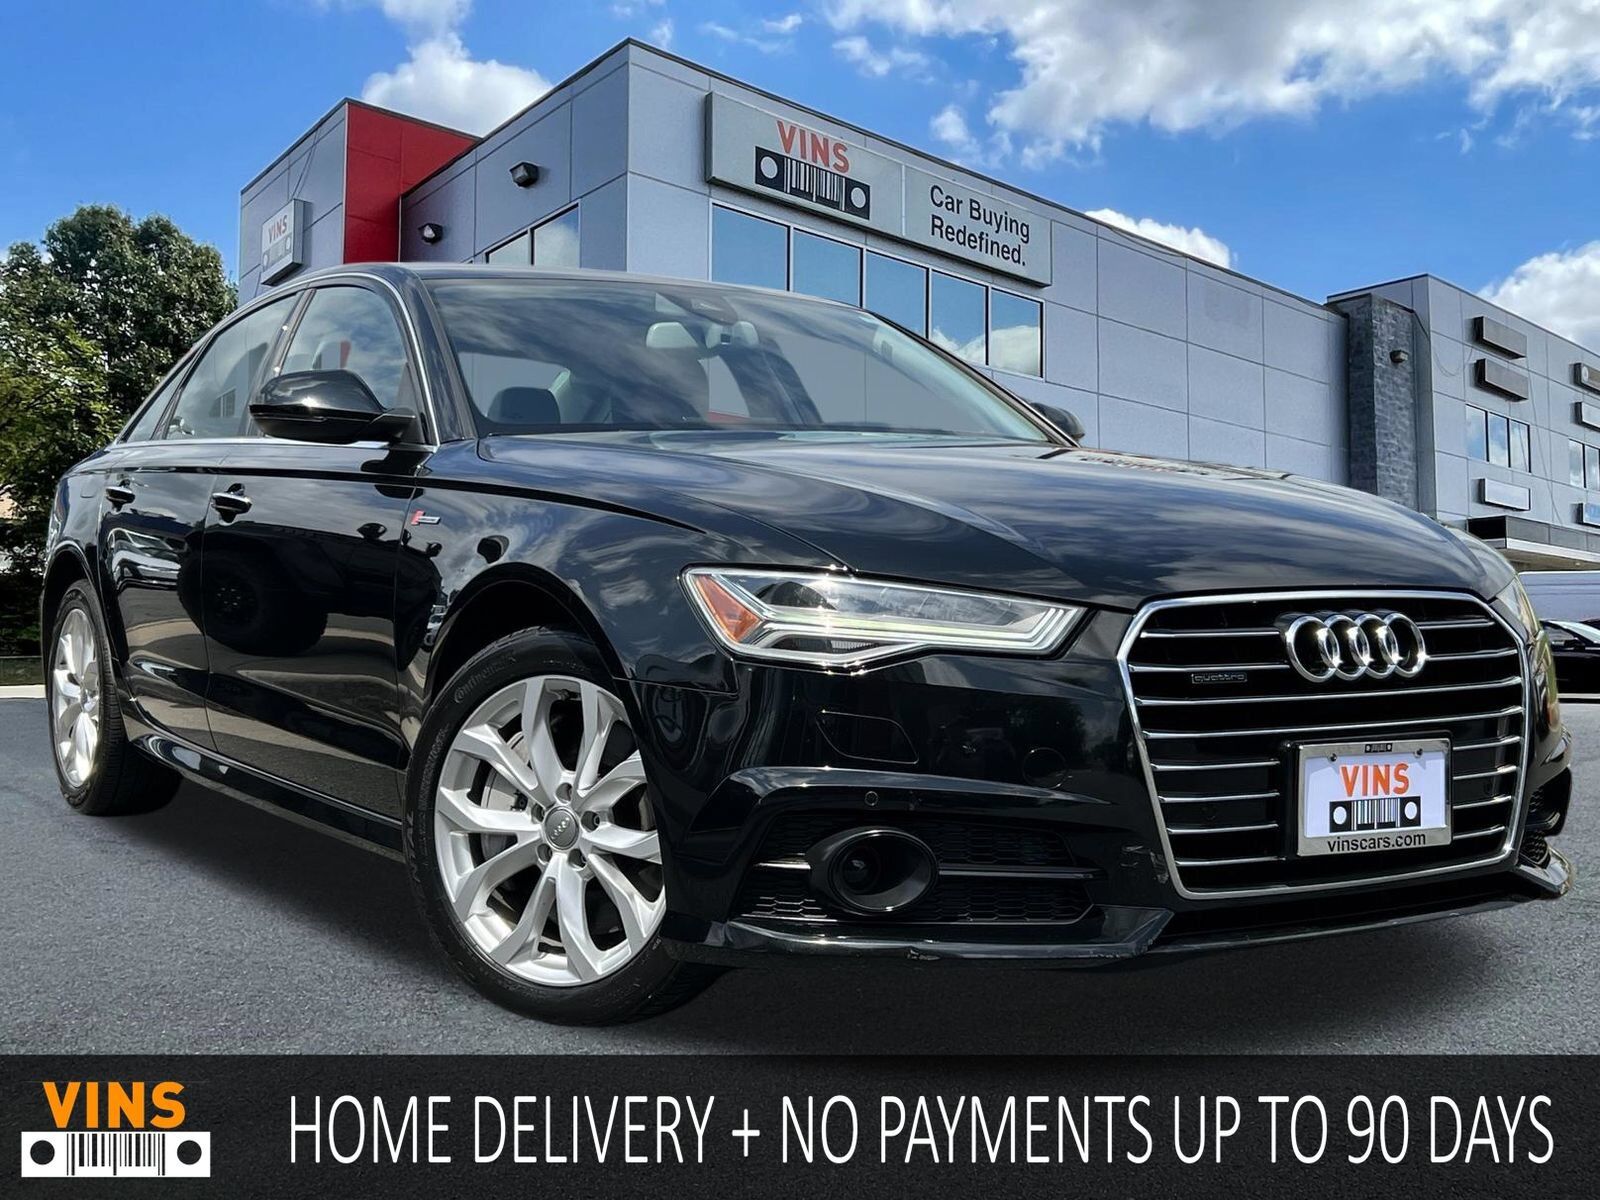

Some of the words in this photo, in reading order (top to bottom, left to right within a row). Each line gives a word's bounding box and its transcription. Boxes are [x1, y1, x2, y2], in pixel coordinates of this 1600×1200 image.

[776, 121, 851, 173] VINS
[268, 214, 288, 244] VINS
[930, 184, 963, 214] Car
[969, 198, 1030, 244] Buying
[930, 214, 1026, 267] Redefined.
[1194, 673, 1245, 683] quattro
[1341, 762, 1410, 798] VINS
[1327, 833, 1426, 853] vinscars.com
